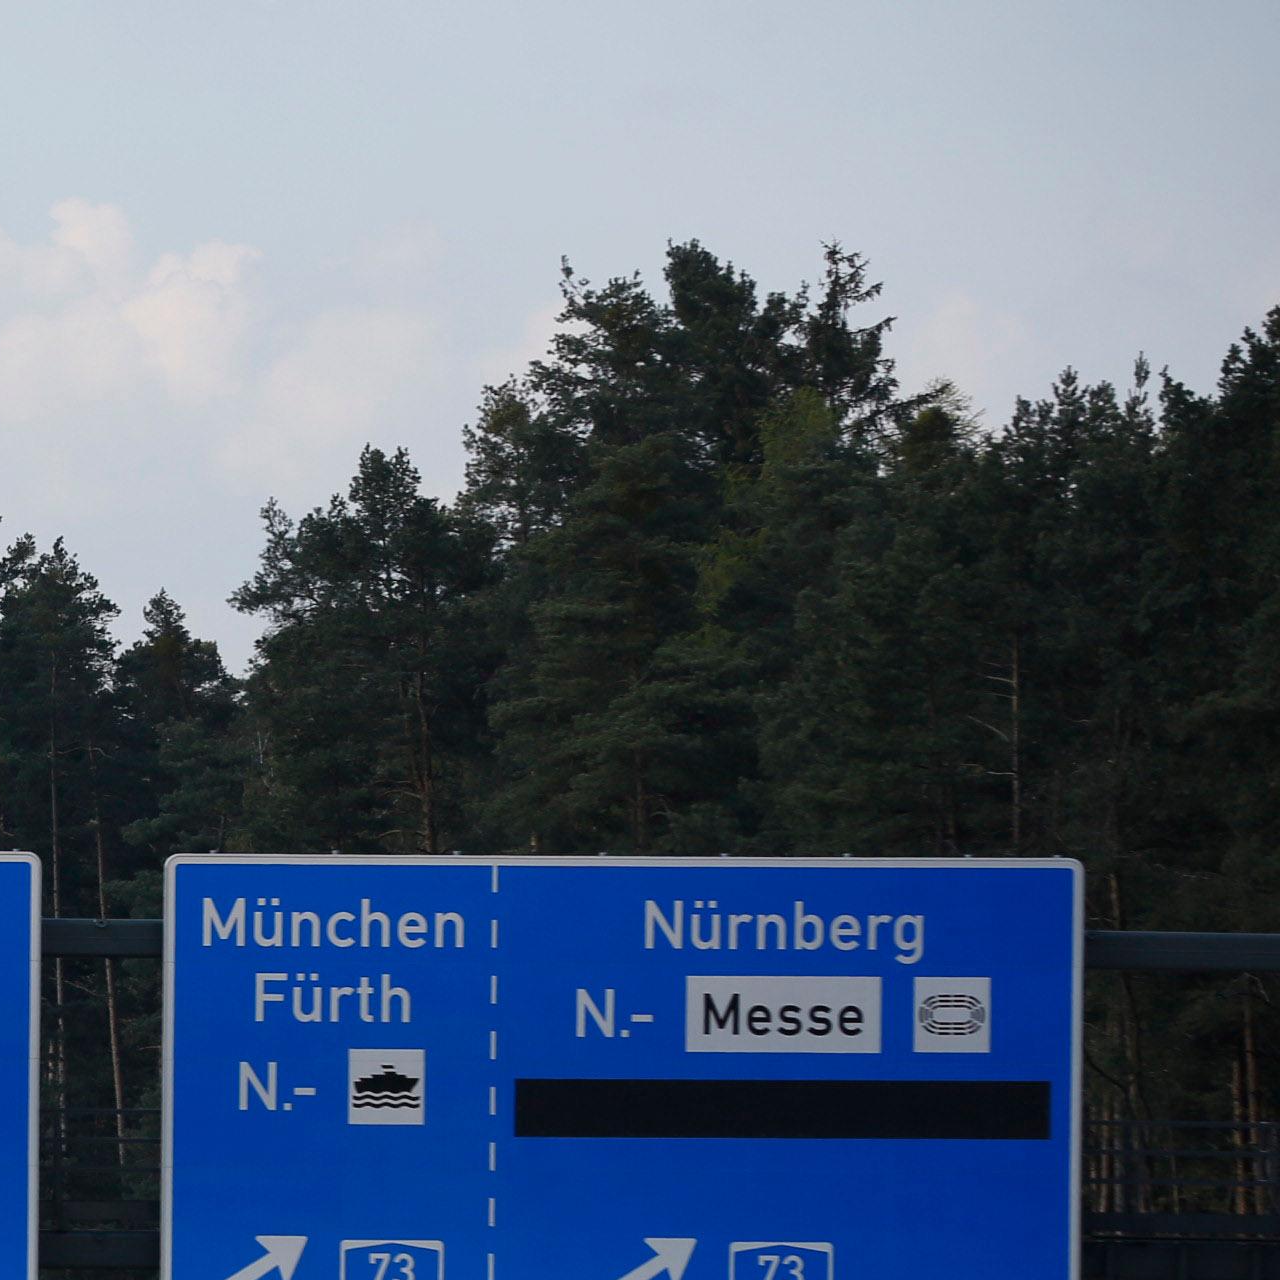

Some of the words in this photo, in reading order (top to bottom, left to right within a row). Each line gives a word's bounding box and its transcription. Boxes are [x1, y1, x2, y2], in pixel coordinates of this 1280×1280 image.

[203, 897, 464, 948] München
[645, 900, 924, 964] Nürnberg
[255, 972, 410, 1023] Fürth
[577, 988, 654, 1038] N.-
[703, 993, 864, 1037] Messe
[239, 1061, 316, 1111] N.-
